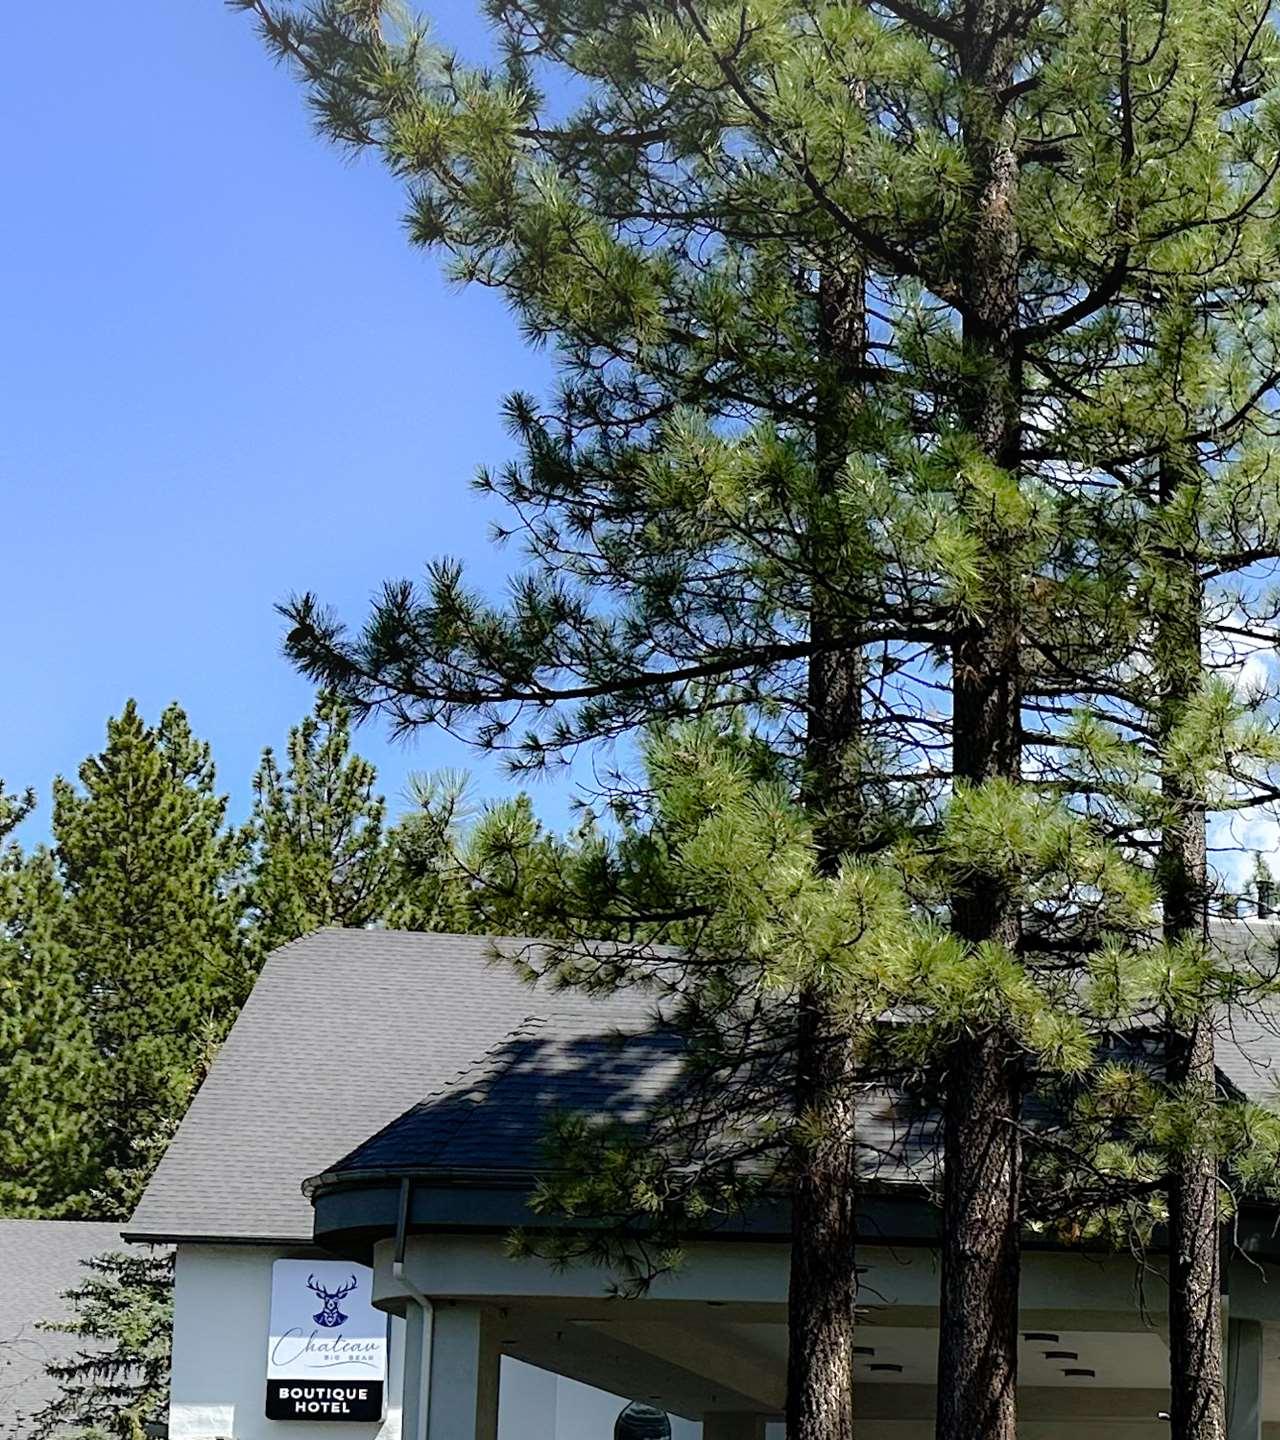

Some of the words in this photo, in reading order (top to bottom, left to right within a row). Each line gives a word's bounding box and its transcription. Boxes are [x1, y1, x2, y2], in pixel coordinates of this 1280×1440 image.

[271, 1327, 380, 1367] Chateau
[279, 1387, 368, 1401] BOUTIQUE
[295, 1401, 350, 1413] HOTEL
